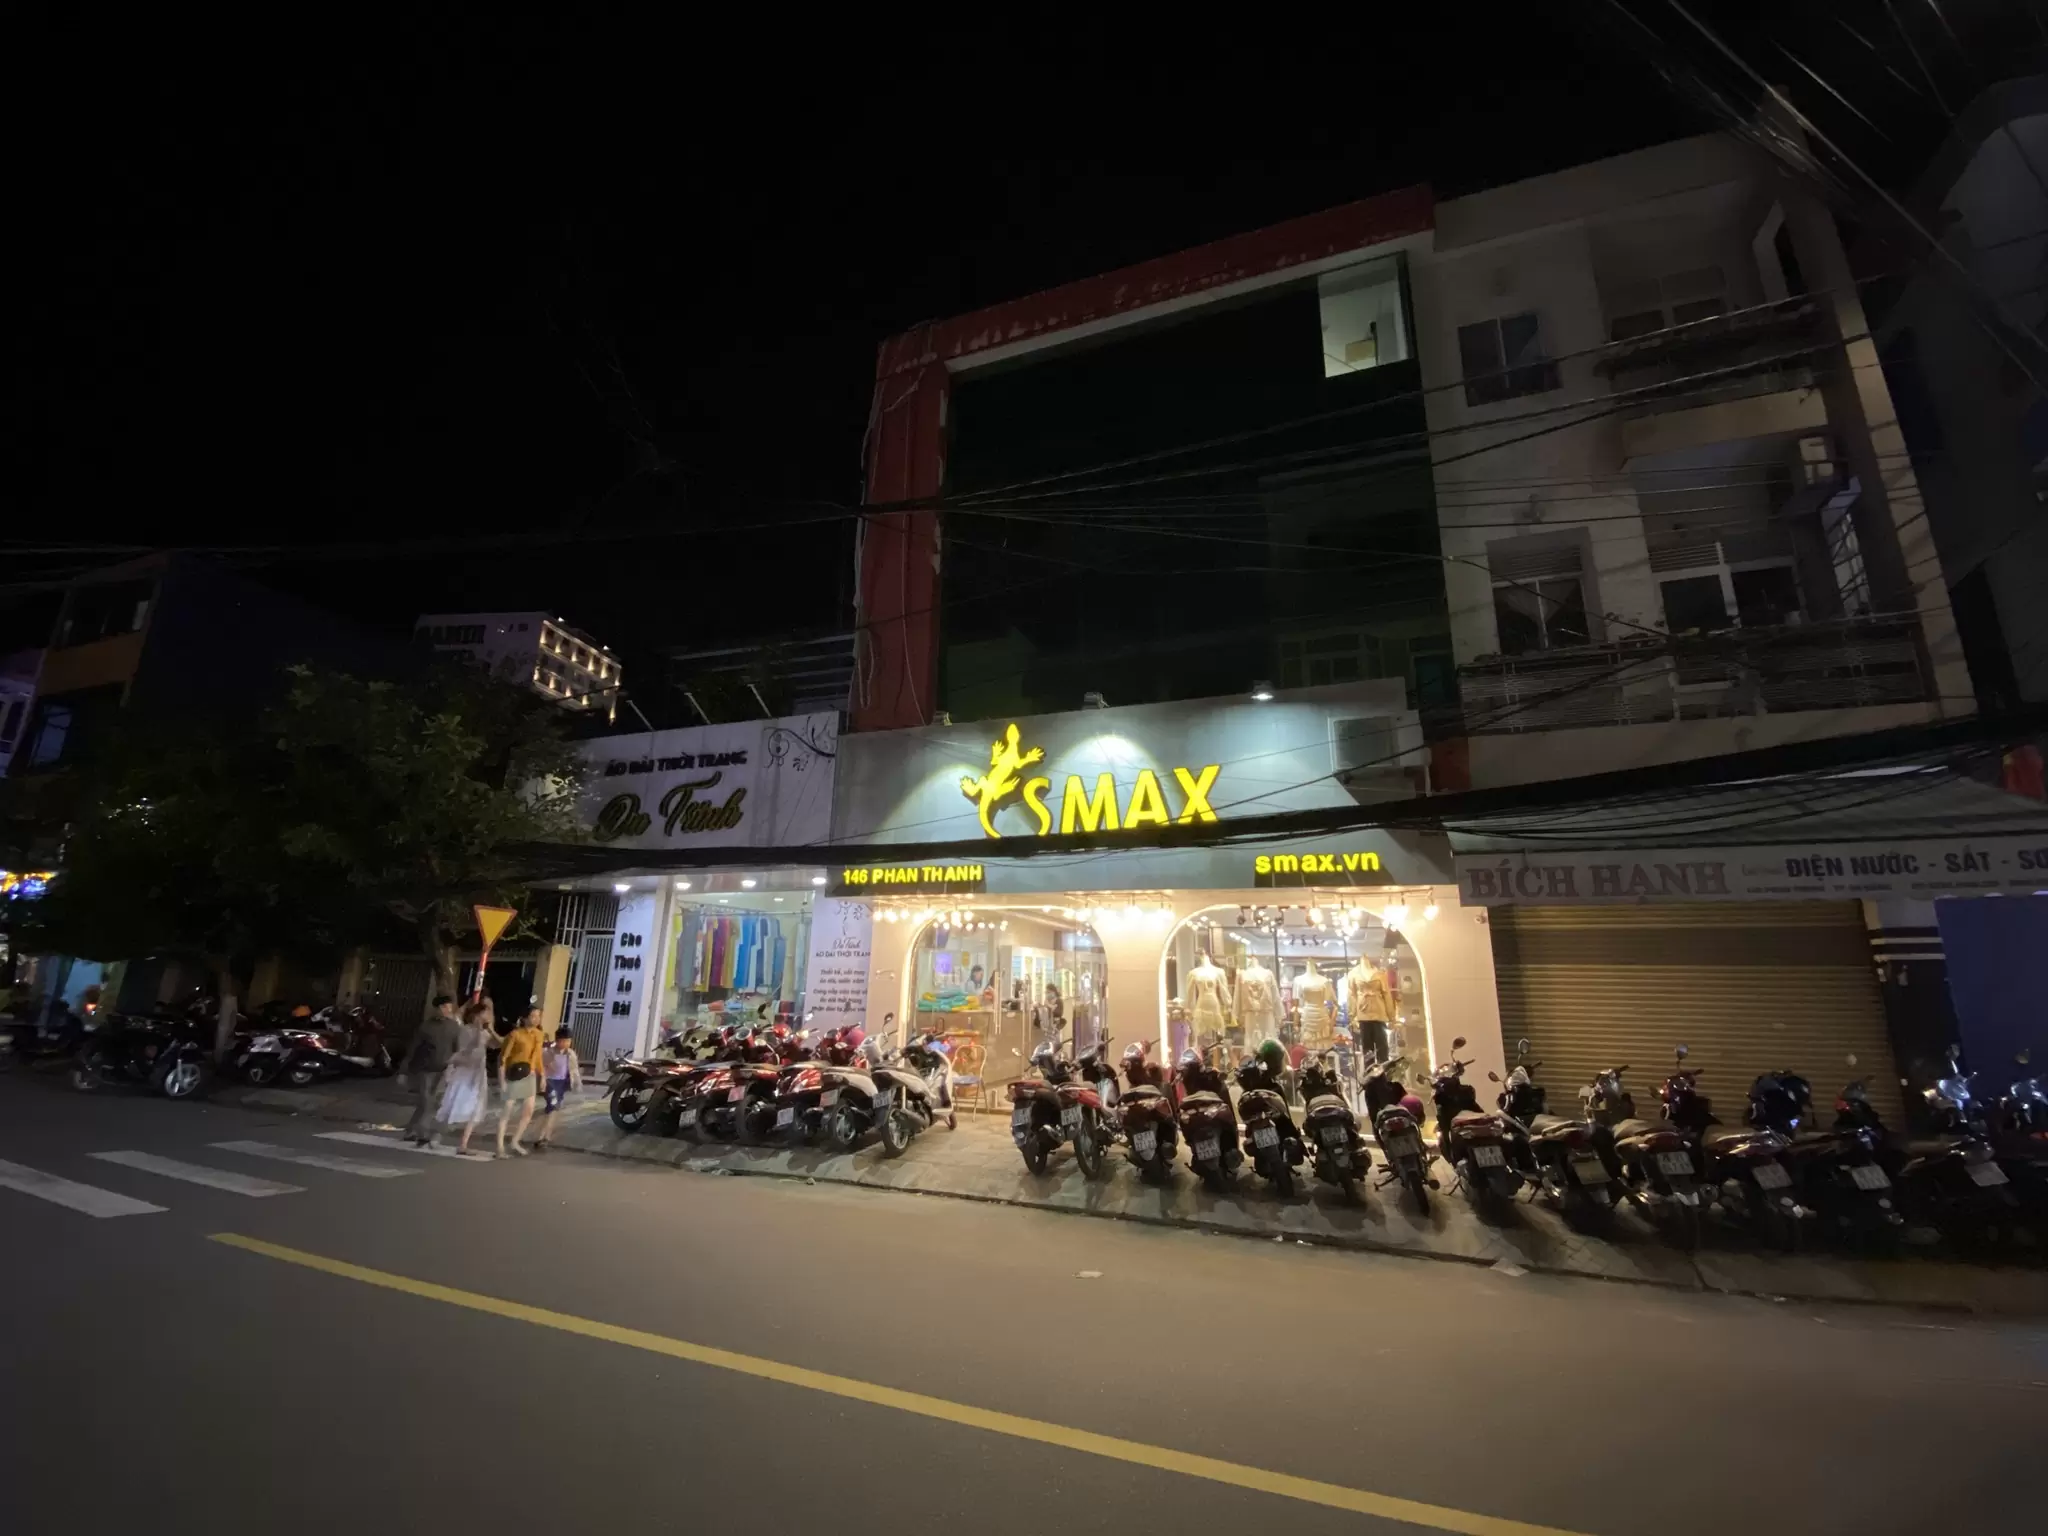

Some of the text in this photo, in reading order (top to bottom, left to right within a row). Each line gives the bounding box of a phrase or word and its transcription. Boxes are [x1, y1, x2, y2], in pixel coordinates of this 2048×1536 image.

[697, 750, 748, 769] TRANG
[1022, 764, 1221, 838] SMAX
[843, 864, 983, 885] 146 PHAN THANH
[1255, 852, 1379, 875] smax.vn
[1466, 858, 1580, 898] BÍCH
[620, 932, 642, 947] Cho
